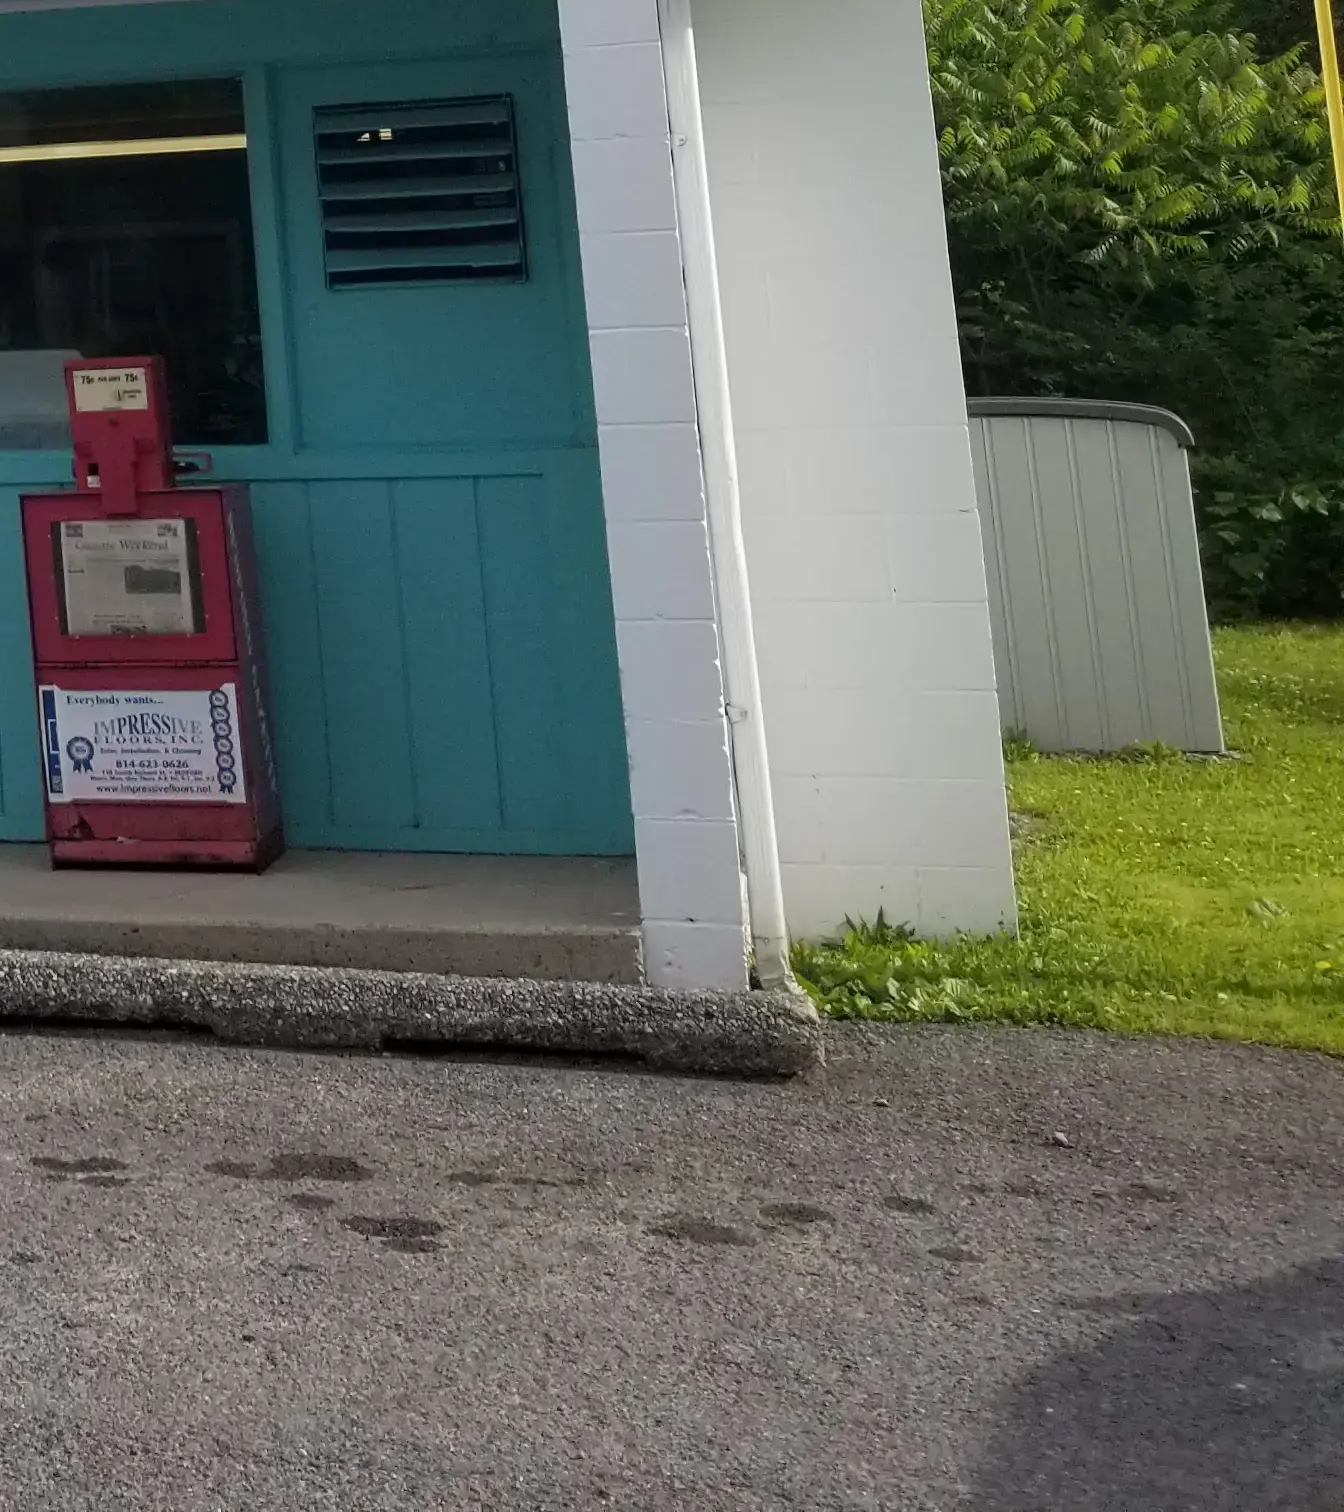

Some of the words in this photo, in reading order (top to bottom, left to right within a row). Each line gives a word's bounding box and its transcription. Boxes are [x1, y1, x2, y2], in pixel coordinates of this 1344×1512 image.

[66, 694, 120, 707] Everybody
[93, 712, 203, 736] IMPRESSIVE
[171, 735, 204, 745] INC.
